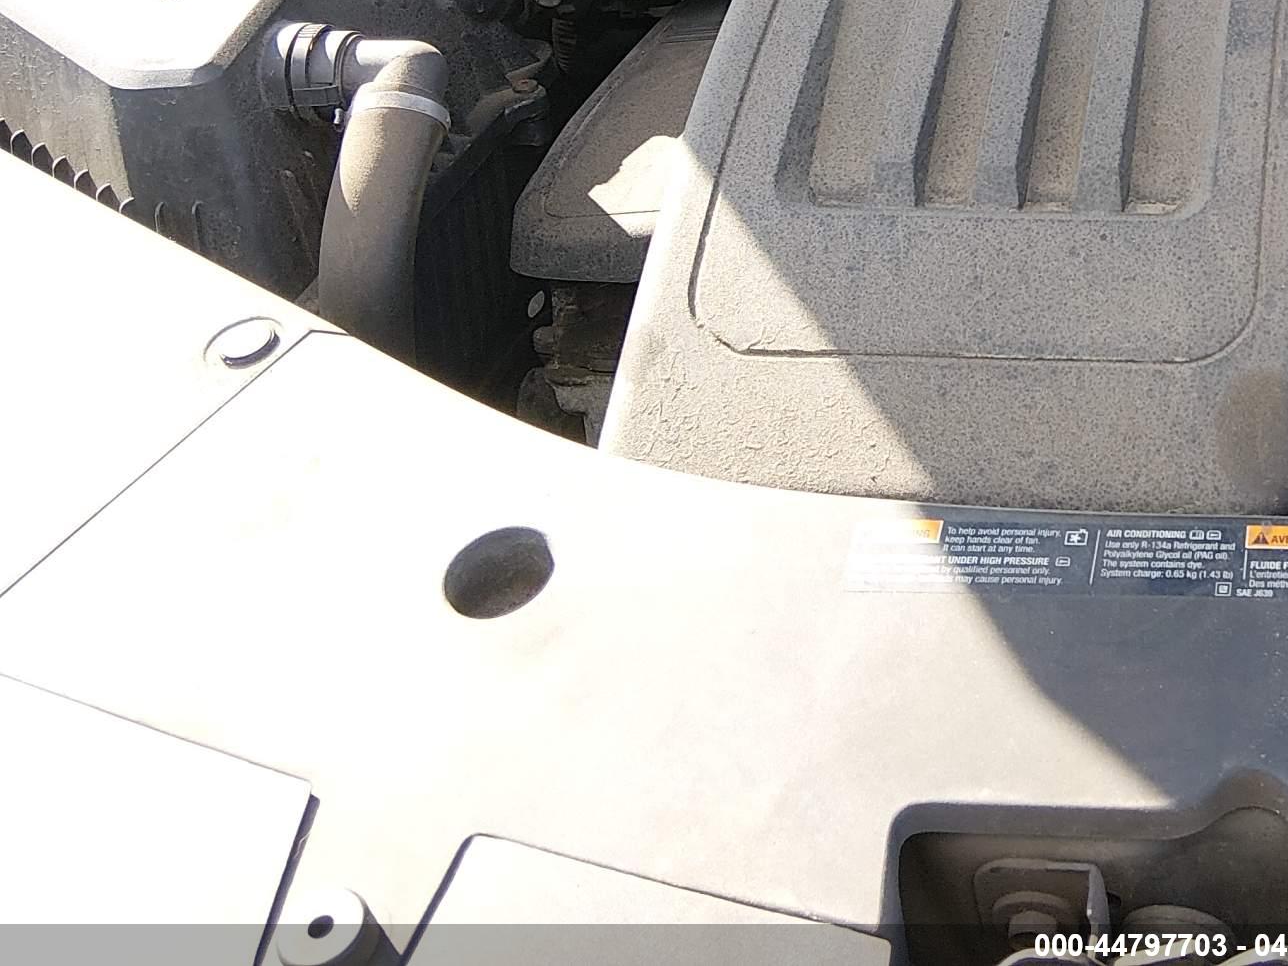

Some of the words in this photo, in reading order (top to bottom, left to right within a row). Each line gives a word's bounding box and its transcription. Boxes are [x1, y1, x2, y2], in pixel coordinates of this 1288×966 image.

[958, 527, 976, 536] help
[977, 527, 1000, 535] avoid
[1001, 528, 1036, 537] personal
[1106, 529, 1122, 538] AIR
[1124, 529, 1186, 539] CONDITIONING
[945, 536, 965, 545] keep
[966, 536, 991, 544] hands
[993, 536, 1013, 544] clear
[1014, 536, 1025, 544] of
[1025, 537, 1040, 545] fan.
[1105, 540, 1120, 549] Use
[1122, 541, 1139, 550] only
[1141, 541, 1171, 549] R-134a
[1173, 541, 1218, 551] Refrigerant
[1220, 542, 1236, 551] and
[967, 545, 987, 553] start
[998, 546, 1013, 554] any
[1015, 545, 1036, 554] time.
[1103, 550, 1154, 559] Polyalkylene
[1155, 551, 1180, 560] Glycol
[1182, 551, 1192, 559] oil
[1194, 551, 1213, 560] (PAG
[948, 556, 978, 564] UNDER
[980, 556, 1001, 564] HIGH
[1003, 557, 1050, 565] PRESSURE
[1103, 559, 1117, 567] The
[1119, 560, 1149, 569] system
[1150, 560, 1185, 569] contains
[1250, 560, 1281, 570] FLUIDE
[953, 566, 989, 575] qualified
[990, 566, 1031, 576] personnel
[1100, 569, 1131, 579] System
[1133, 569, 1164, 579] charge:
[1165, 570, 1185, 578] 0.65
[1186, 570, 1197, 580] kg
[1199, 570, 1220, 580] (1.43
[1222, 571, 1233, 580] lb)
[954, 576, 973, 585] may
[1001, 577, 1037, 585] personal
[1249, 580, 1265, 588] Des
